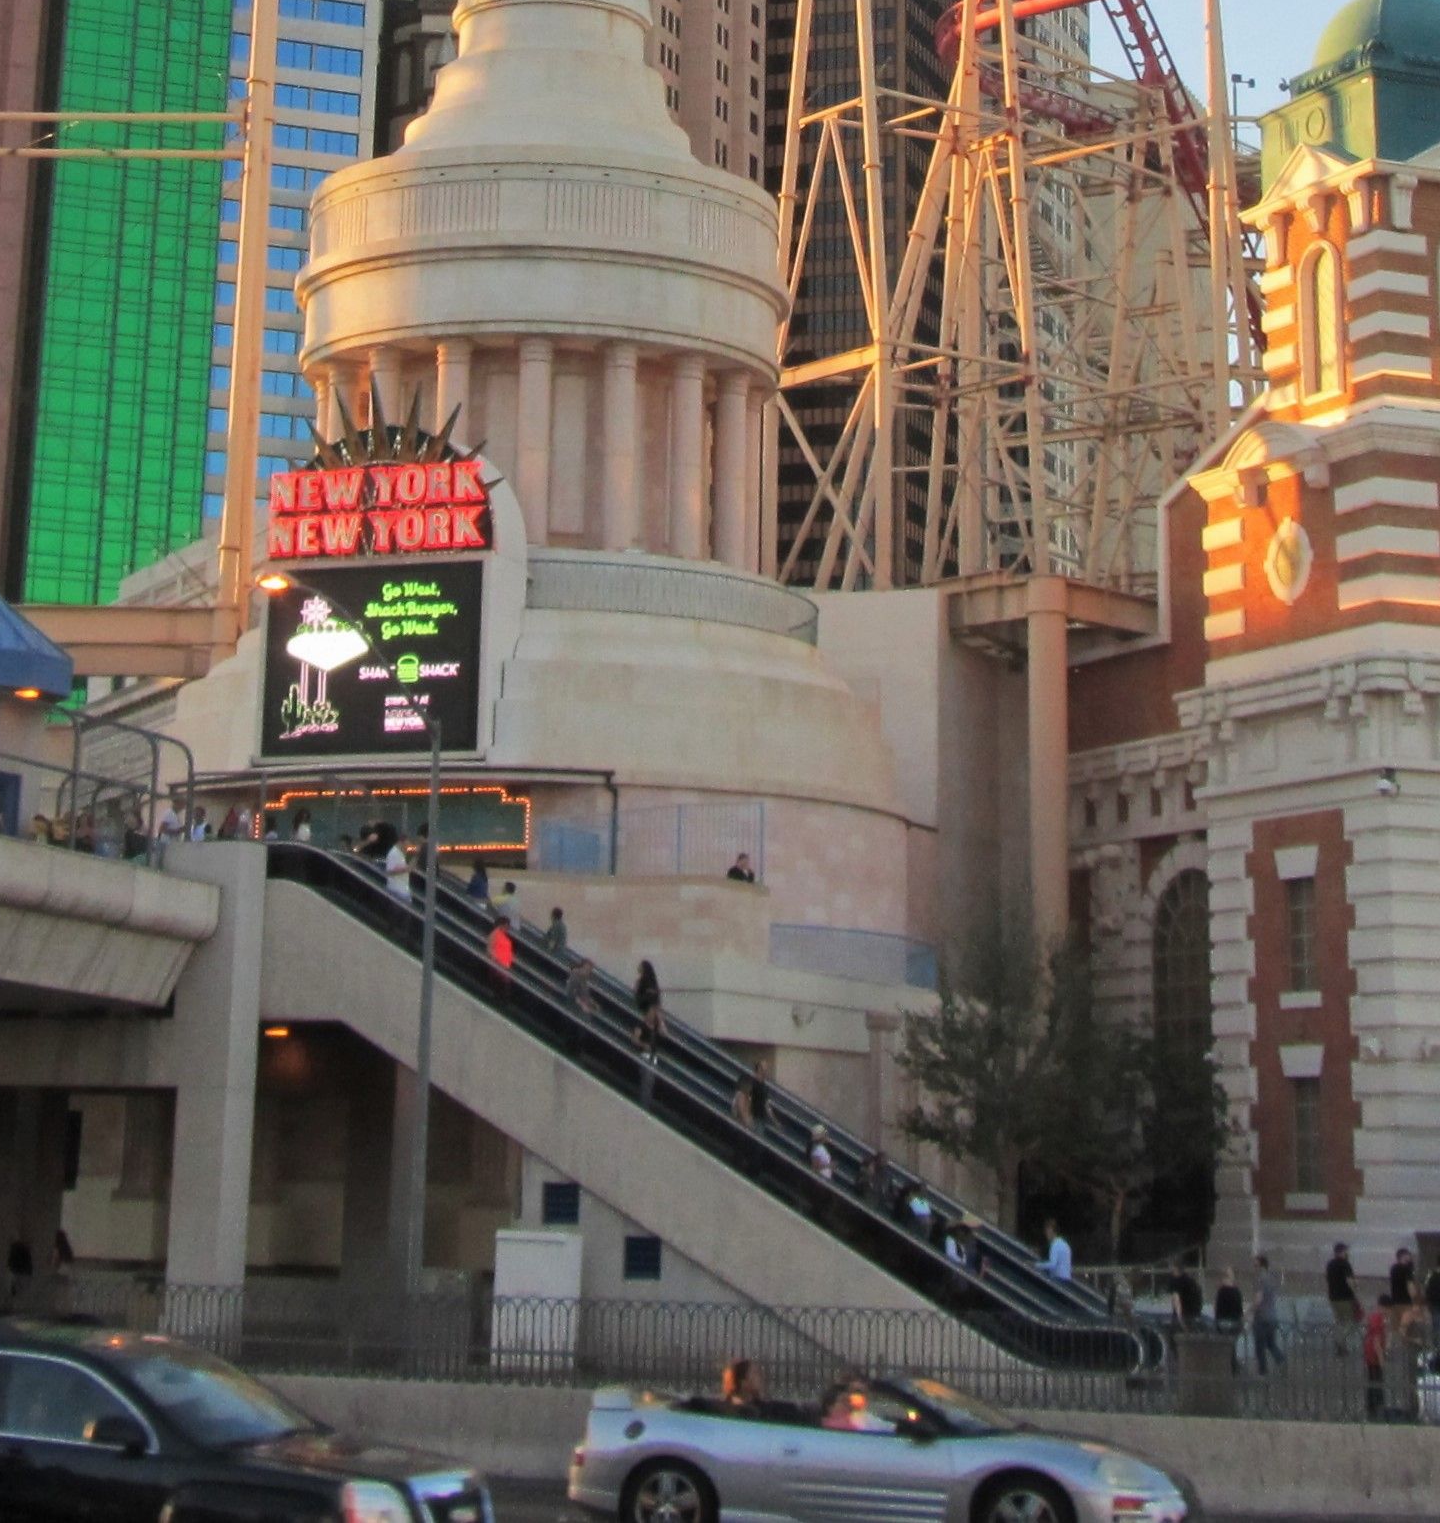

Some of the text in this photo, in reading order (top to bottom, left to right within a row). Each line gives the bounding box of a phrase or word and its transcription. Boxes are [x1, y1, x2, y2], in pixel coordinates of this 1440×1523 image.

[271, 461, 486, 511] NEW YORK
[268, 506, 486, 558] NEW YORK
[382, 583, 402, 602] Go
[381, 621, 401, 640] Go
[419, 663, 460, 678] SHACK
